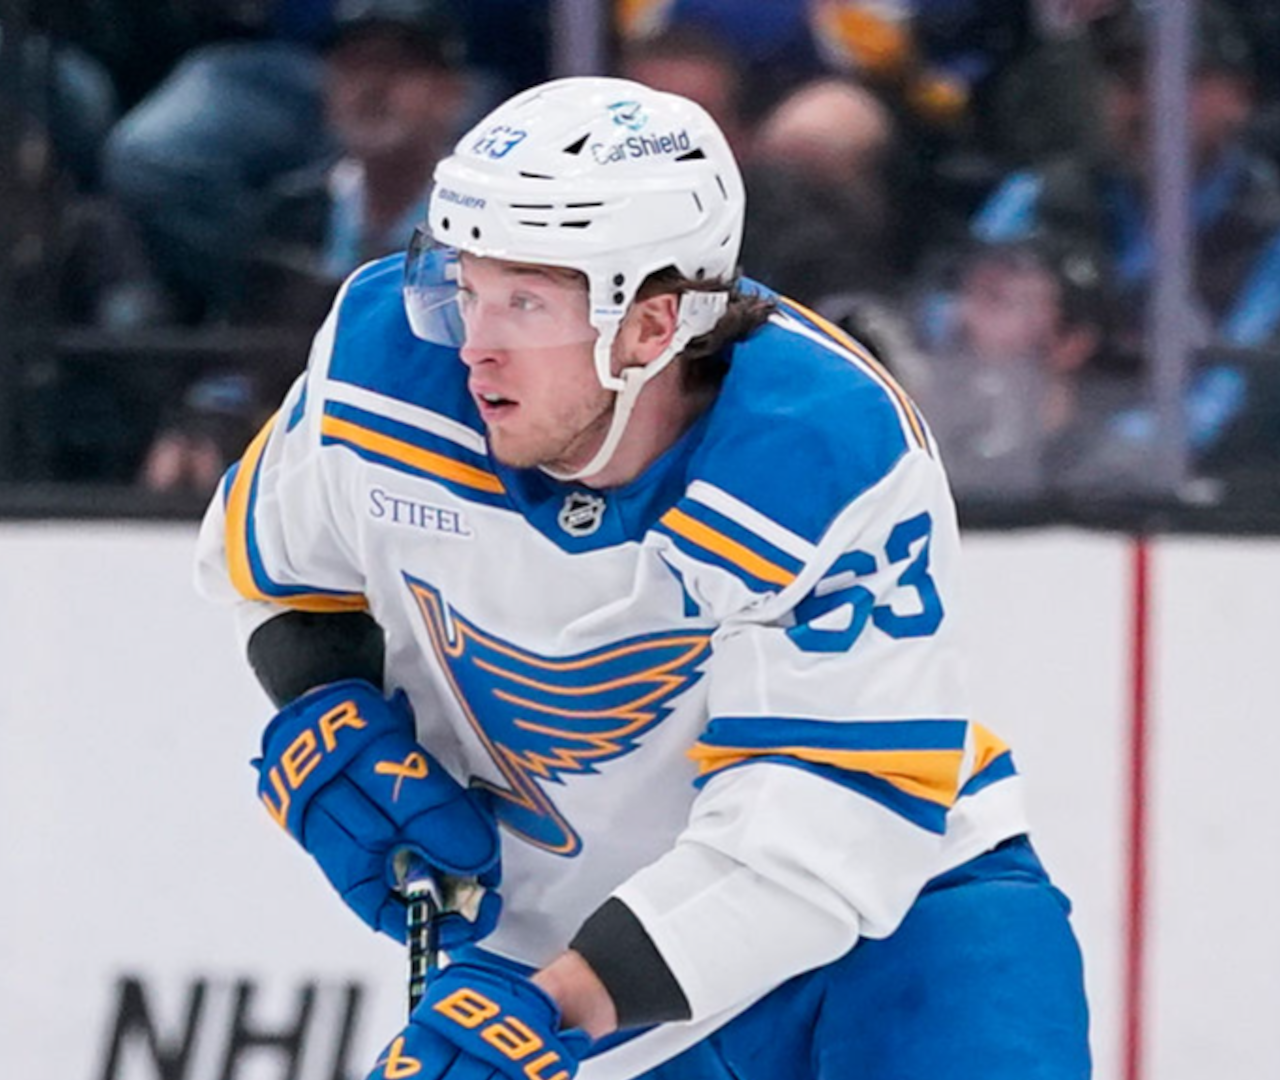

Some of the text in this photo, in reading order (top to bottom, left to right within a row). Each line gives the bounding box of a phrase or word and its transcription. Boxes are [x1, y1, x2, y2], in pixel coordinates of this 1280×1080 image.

[591, 129, 691, 165] CarShield
[369, 488, 472, 537] STIFEL
[785, 509, 946, 654] 63
